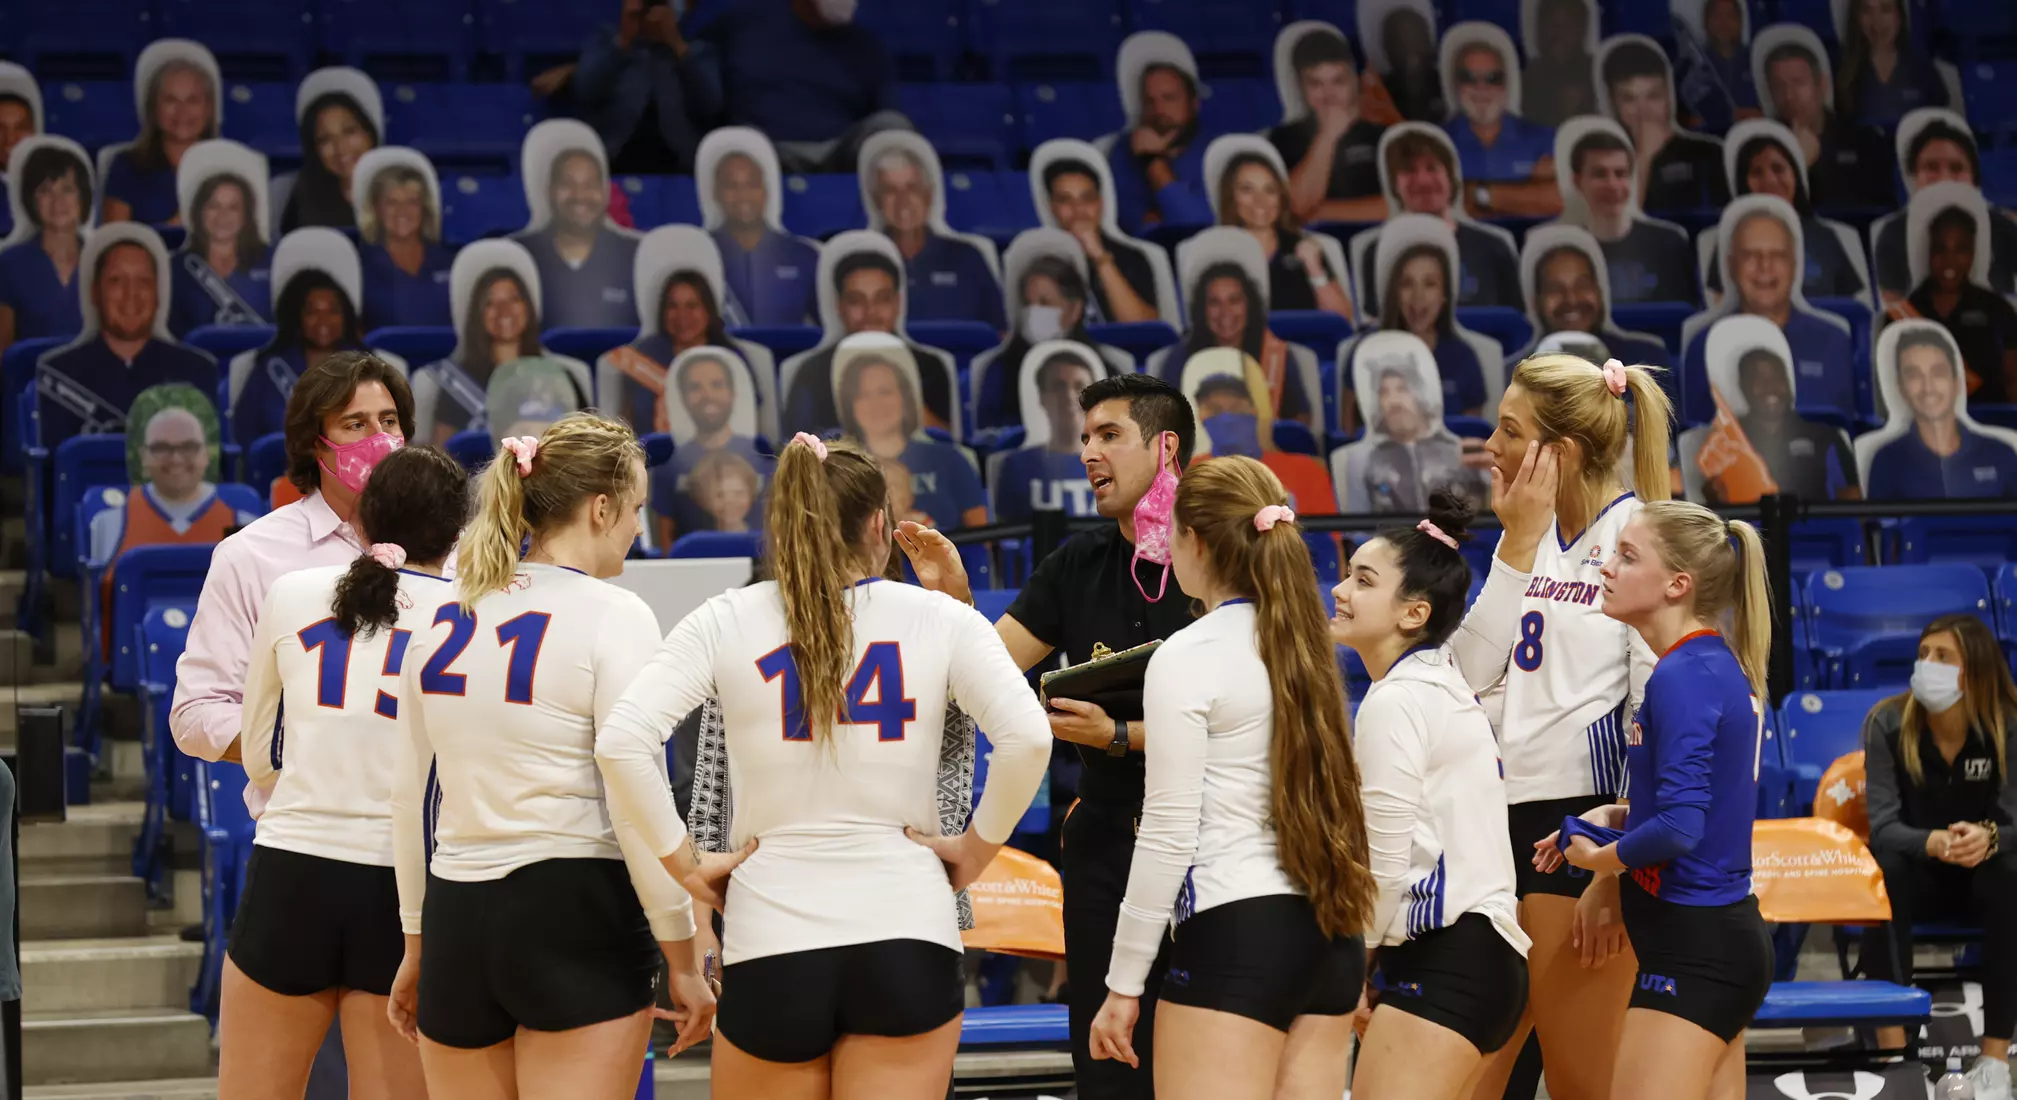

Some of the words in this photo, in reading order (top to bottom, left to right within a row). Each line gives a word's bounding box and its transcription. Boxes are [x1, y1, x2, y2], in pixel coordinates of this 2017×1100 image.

[1029, 478, 1098, 517] UT
[420, 601, 551, 705] 21
[1514, 610, 1544, 672] 8
[755, 641, 916, 741] 14
[1640, 973, 1677, 997] UTA
